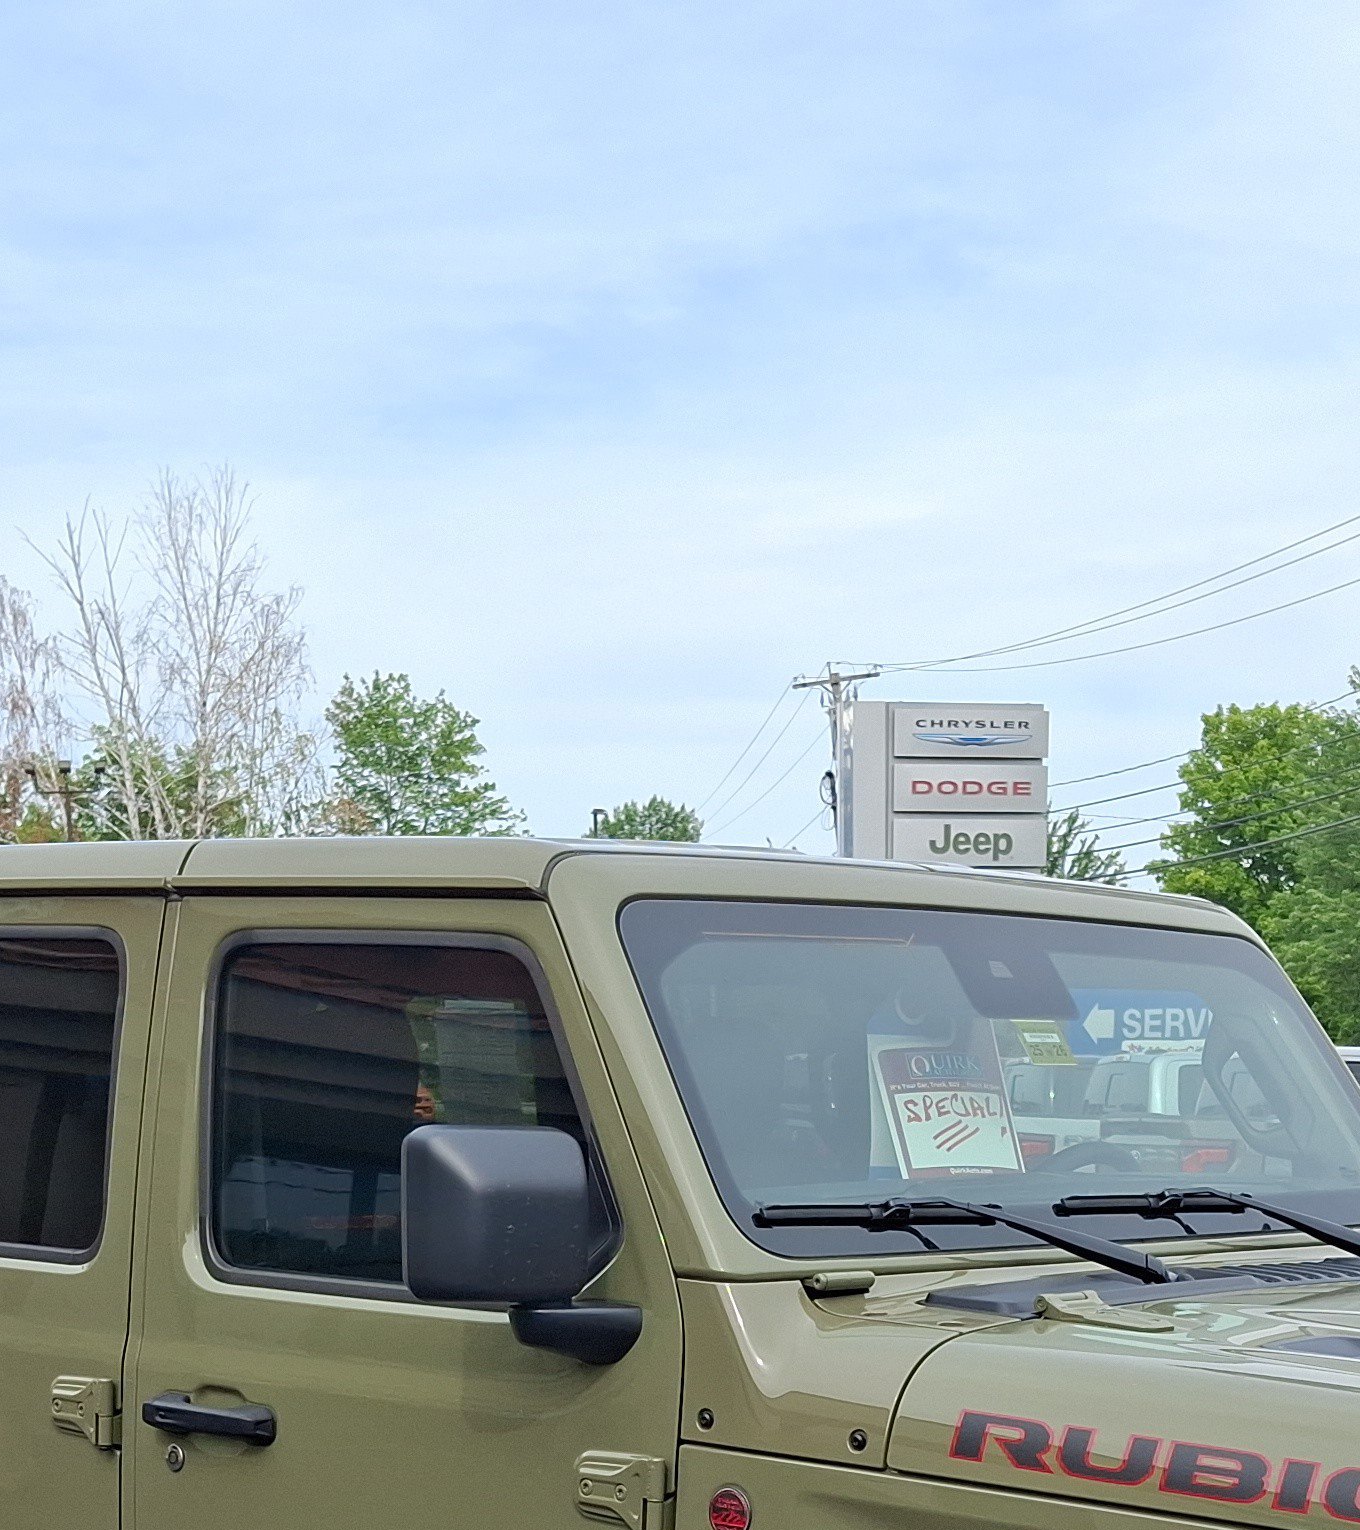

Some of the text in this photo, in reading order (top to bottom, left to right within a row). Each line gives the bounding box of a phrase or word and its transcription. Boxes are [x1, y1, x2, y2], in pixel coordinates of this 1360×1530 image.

[915, 719, 1030, 730] CHRYSLER
[911, 780, 1032, 796] DODGE
[929, 824, 1013, 861] Jeep
[1122, 1008, 1213, 1039] SERV
[911, 1054, 980, 1077] QUIRK
